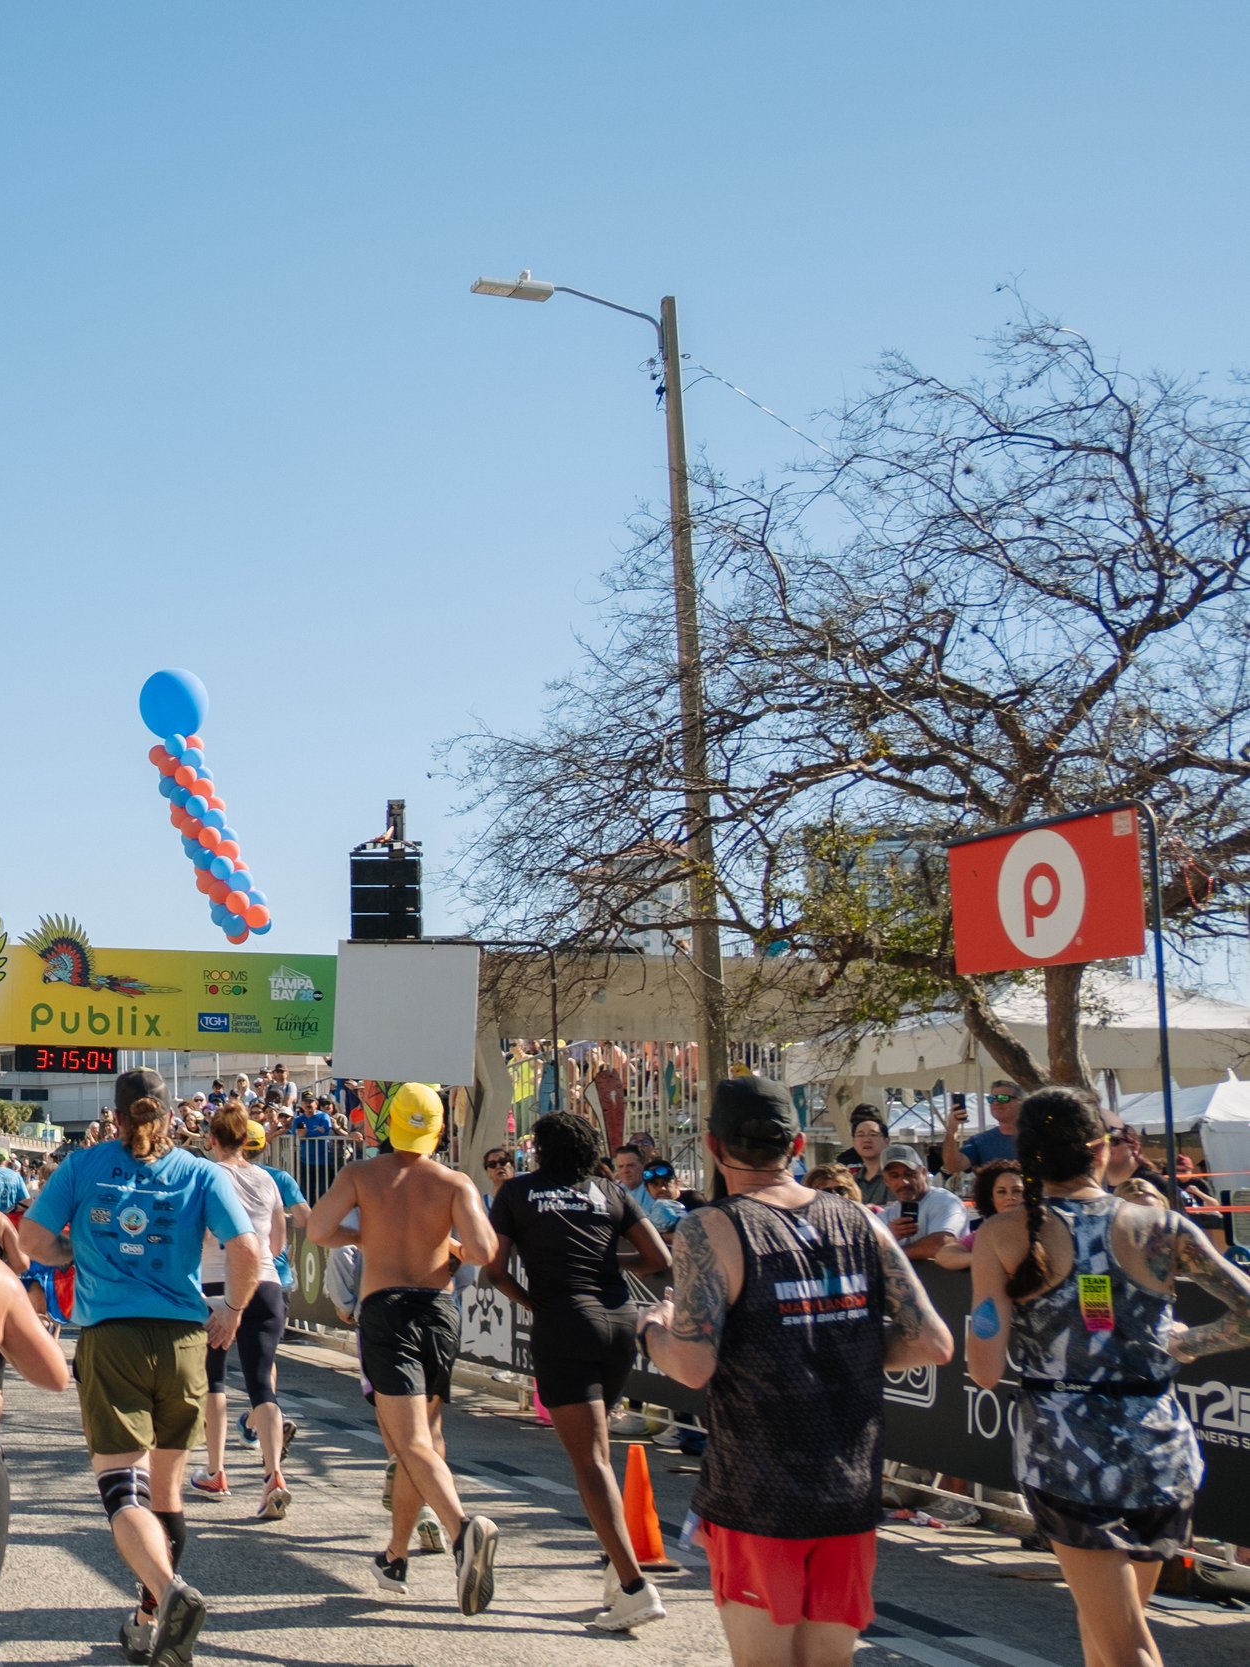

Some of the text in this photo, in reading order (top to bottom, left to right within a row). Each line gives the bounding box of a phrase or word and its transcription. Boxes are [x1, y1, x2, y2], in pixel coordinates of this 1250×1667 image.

[203, 969, 248, 981] ROOMS
[268, 977, 315, 990] TAMPA
[204, 984, 243, 996] TO GO
[270, 990, 298, 1001] BAY
[298, 990, 314, 1001] 28
[30, 1002, 162, 1038] Publix
[203, 1015, 228, 1026] TGH
[232, 1013, 256, 1022] Tampa
[231, 1020, 260, 1029] General
[273, 1016, 319, 1037] Tampa
[231, 1027, 262, 1035] Hospital
[537, 1200, 587, 1214] Wellness
[1082, 1277, 1108, 1285] TEAM
[816, 1311, 847, 1323] BIKE
[963, 1385, 1002, 1440] TO
